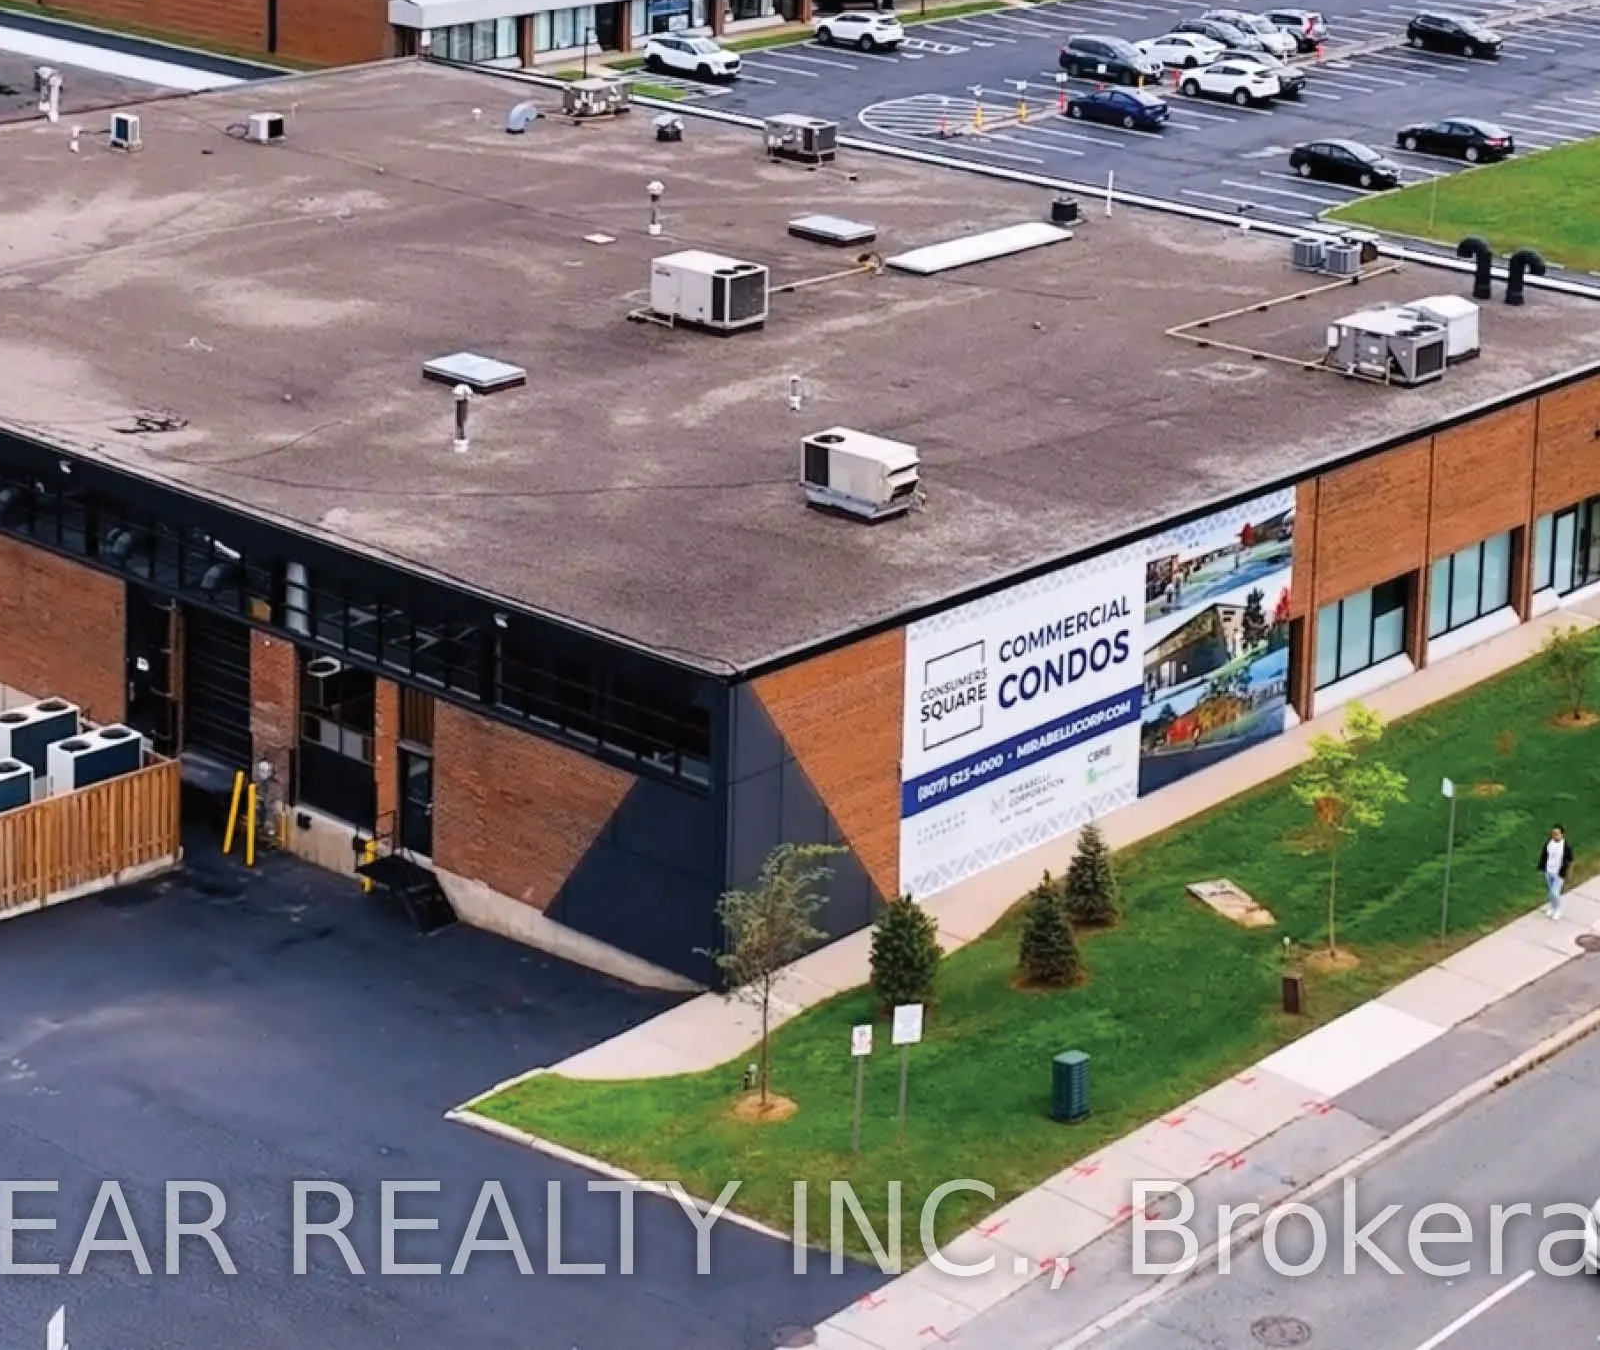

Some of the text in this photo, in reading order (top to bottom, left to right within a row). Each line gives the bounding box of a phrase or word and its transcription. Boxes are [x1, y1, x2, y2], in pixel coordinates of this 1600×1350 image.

[1000, 595, 1130, 662] COMMERCIAL
[920, 667, 988, 703] CONSUMERS
[998, 628, 1130, 710] CONDOS
[920, 682, 988, 723] SQUARE
